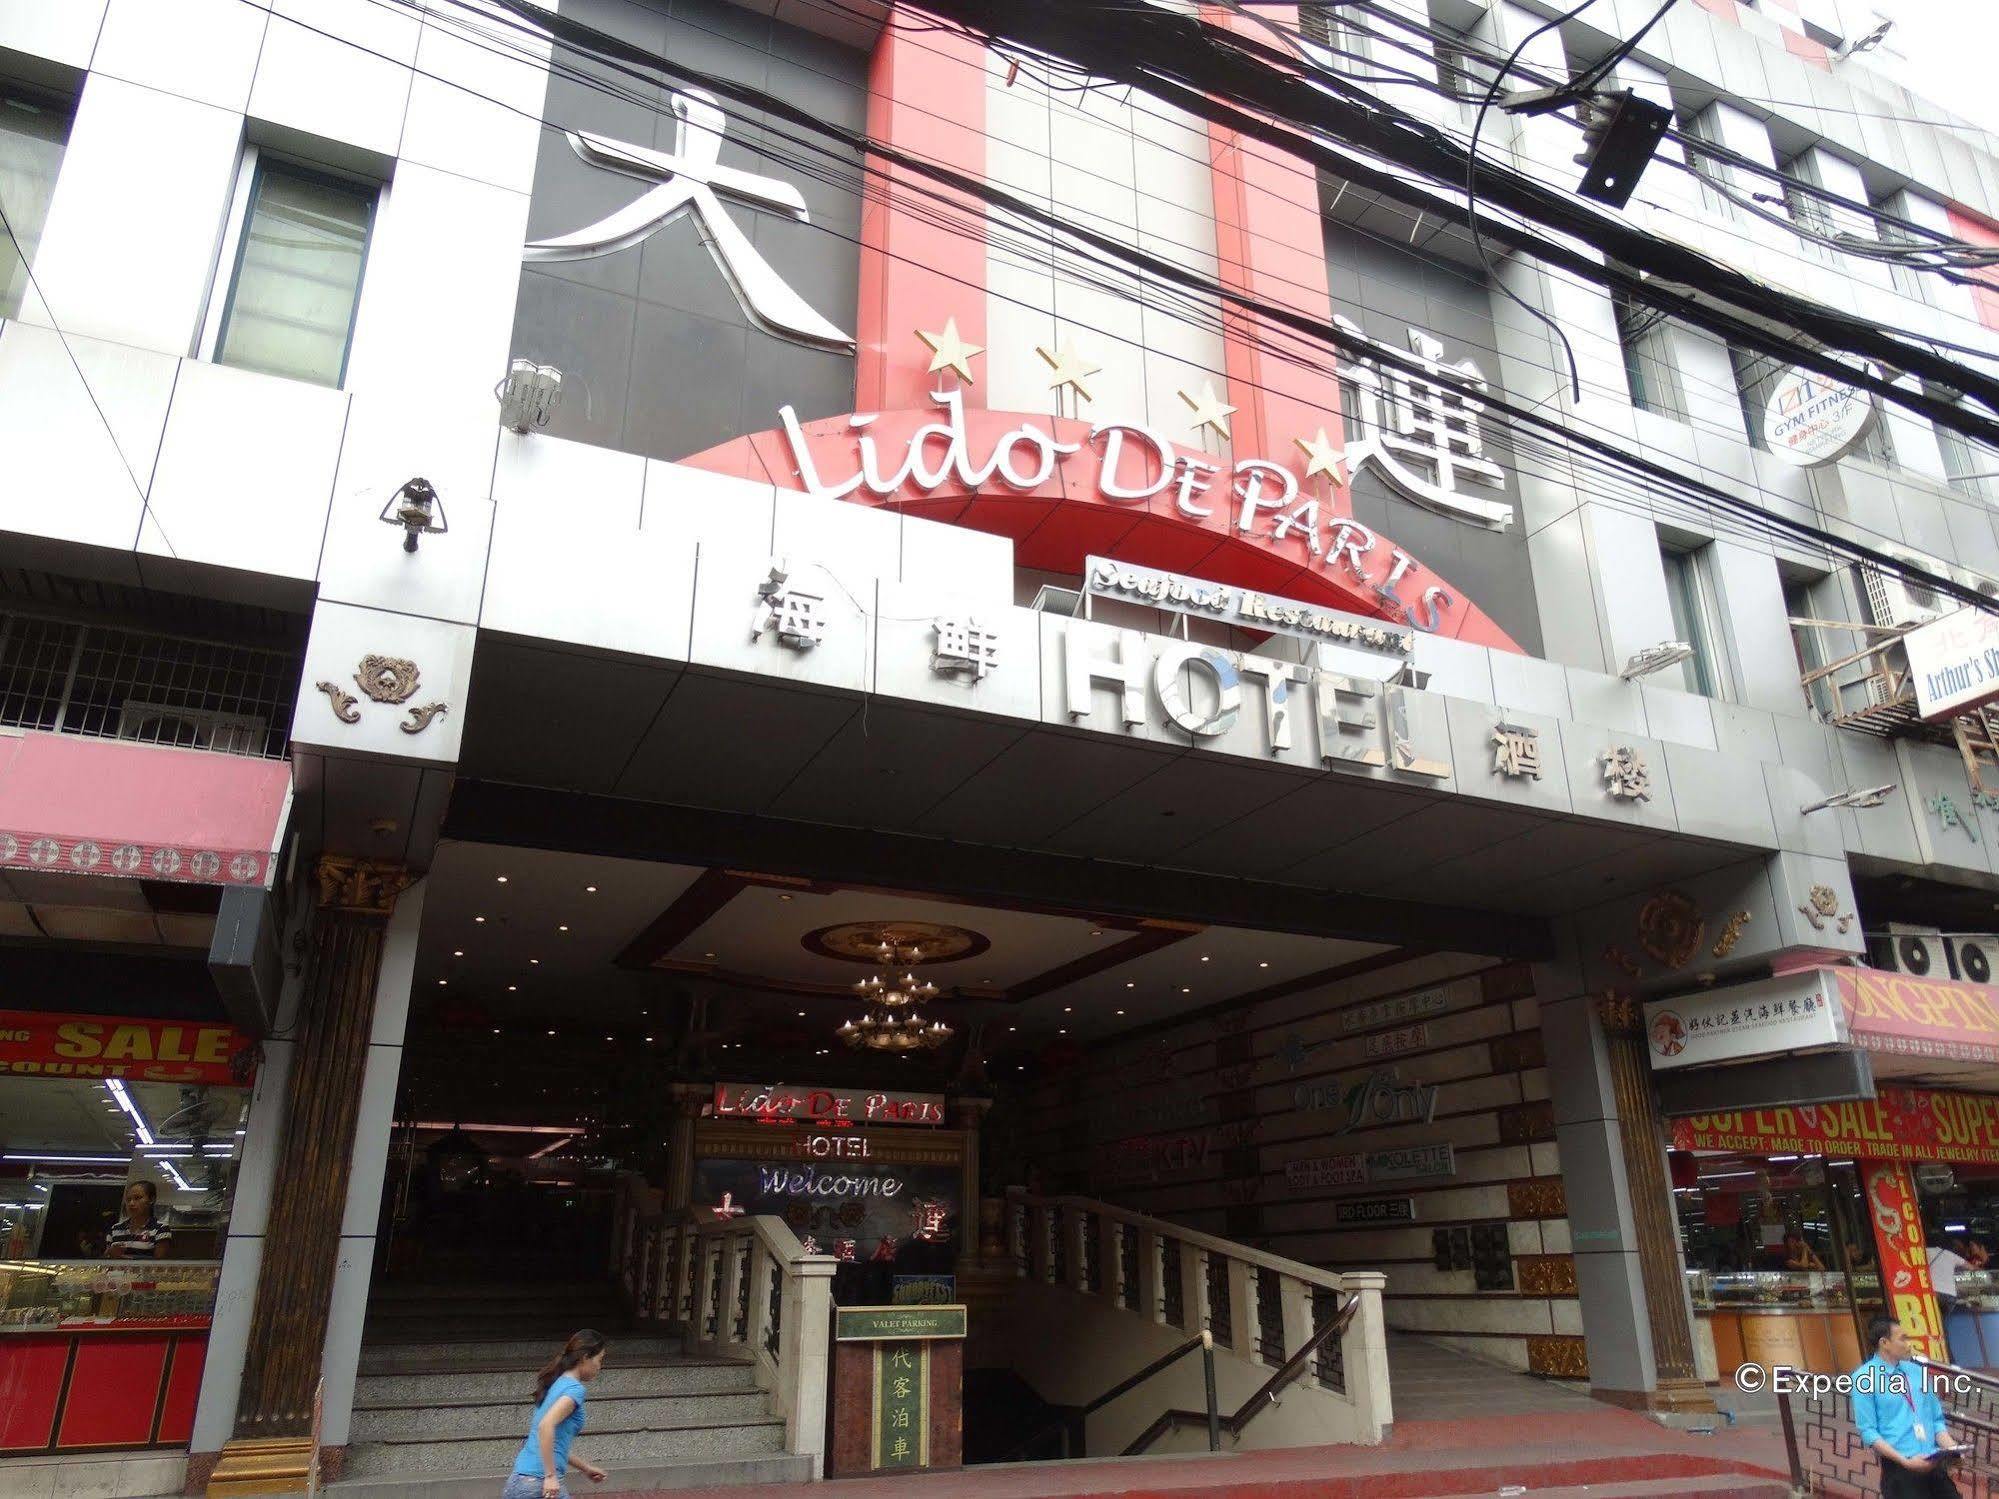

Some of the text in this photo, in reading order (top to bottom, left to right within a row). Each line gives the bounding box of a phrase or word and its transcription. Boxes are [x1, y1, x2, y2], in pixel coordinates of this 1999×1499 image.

[524, 86, 857, 357] 大
[1774, 411, 1806, 437] GYM
[777, 391, 1455, 634] Lido DE PARIS
[1092, 560, 1415, 652] Seafood Restaurant
[1064, 617, 1452, 781] HOTEL
[1926, 656, 1984, 702] Arthur's
[53, 1020, 233, 1064] SALE
[715, 1082, 946, 1122] Lido DE PARIS
[1821, 1090, 1894, 1142] SALE
[1928, 1092, 1999, 1147] SUPE
[794, 1134, 872, 1158] HOTEL
[1320, 1154, 1361, 1170] WOMEN
[1694, 1133, 1718, 1148] WE
[1771, 1138, 1805, 1152] MADE
[1806, 1139, 1823, 1154] TO
[1866, 1142, 1901, 1158] TRADE
[1901, 1144, 1914, 1158] IN
[1914, 1145, 1935, 1159] ALL
[1935, 1146, 1981, 1162] JEWELRY
[759, 1162, 904, 1198] Welcome
[1356, 1203, 1387, 1217] FLOOR
[873, 1319, 938, 1329] VALET PARKING
[891, 1345, 912, 1462] 代客泊車
